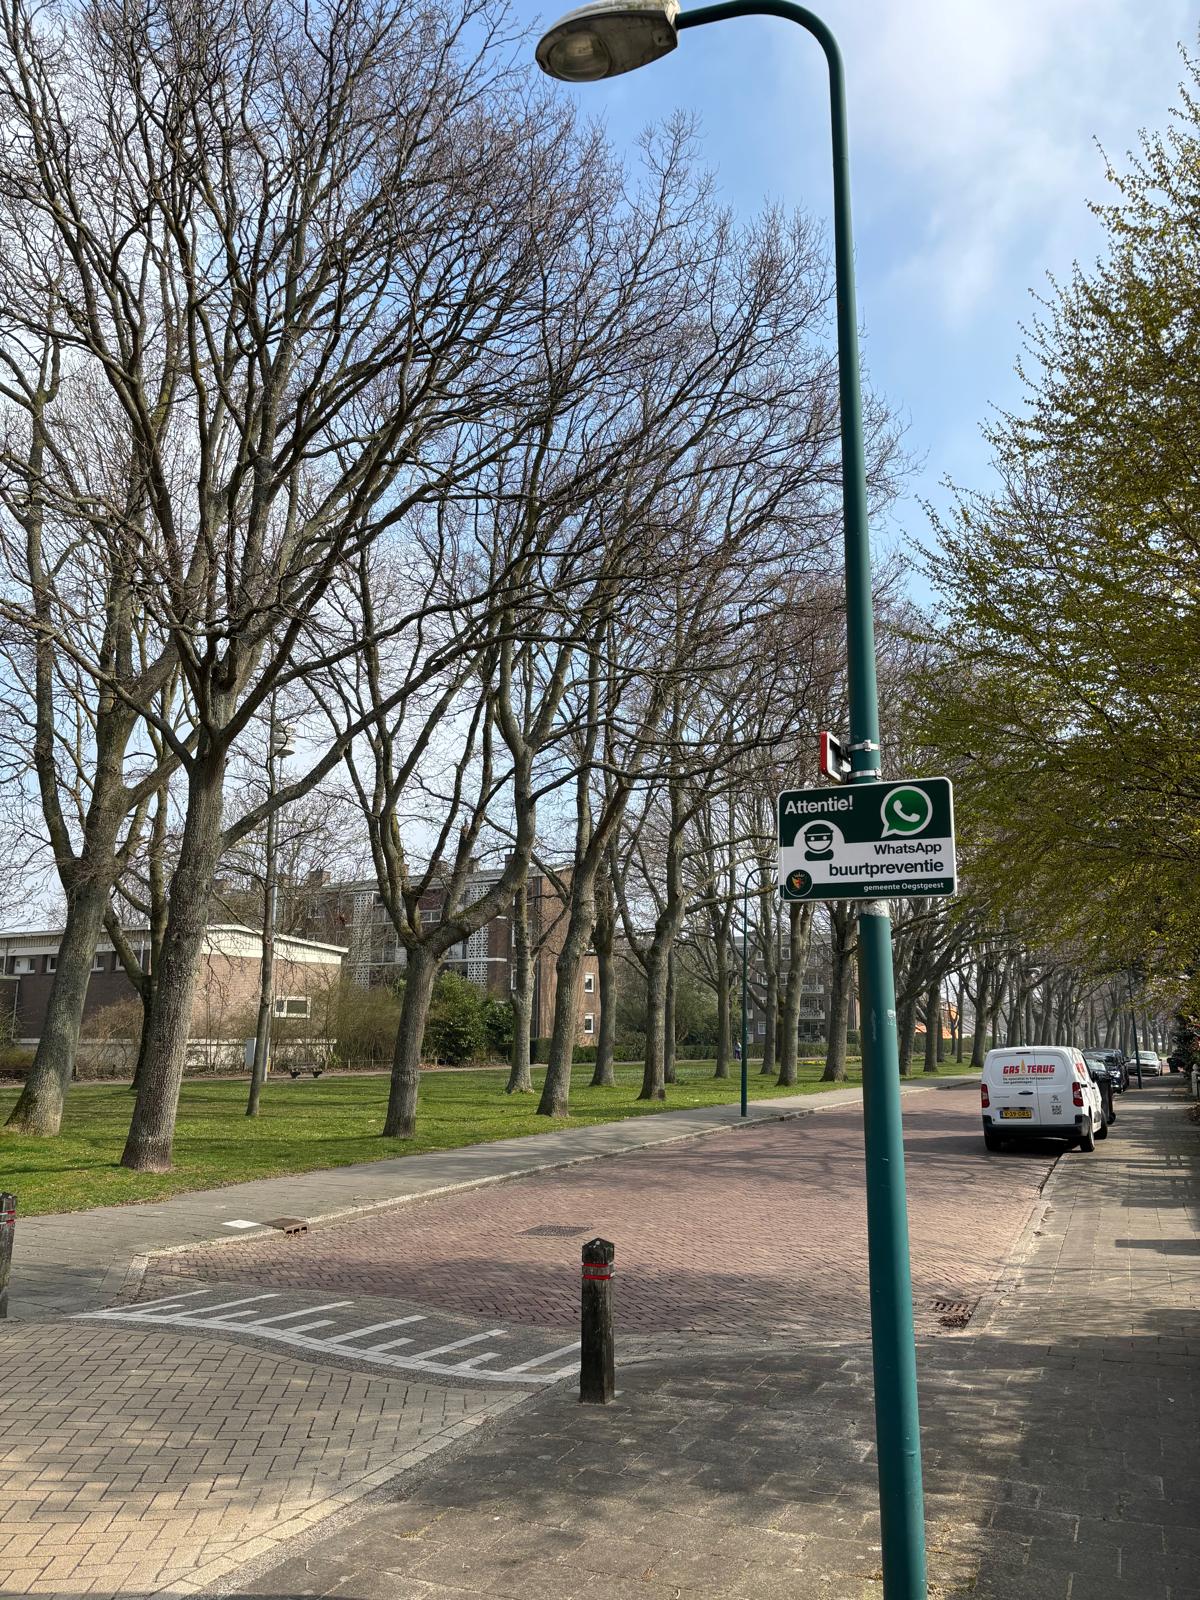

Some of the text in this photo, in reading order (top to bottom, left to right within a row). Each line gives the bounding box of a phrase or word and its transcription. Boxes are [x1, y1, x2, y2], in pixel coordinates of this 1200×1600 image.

[784, 795, 853, 816] Attentie!
[874, 842, 942, 855] WhatsApp
[829, 859, 944, 878] buurtpreventie
[863, 882, 944, 892] gemeente Oegstgeest
[1003, 1065, 1055, 1074] GAS TERUG
